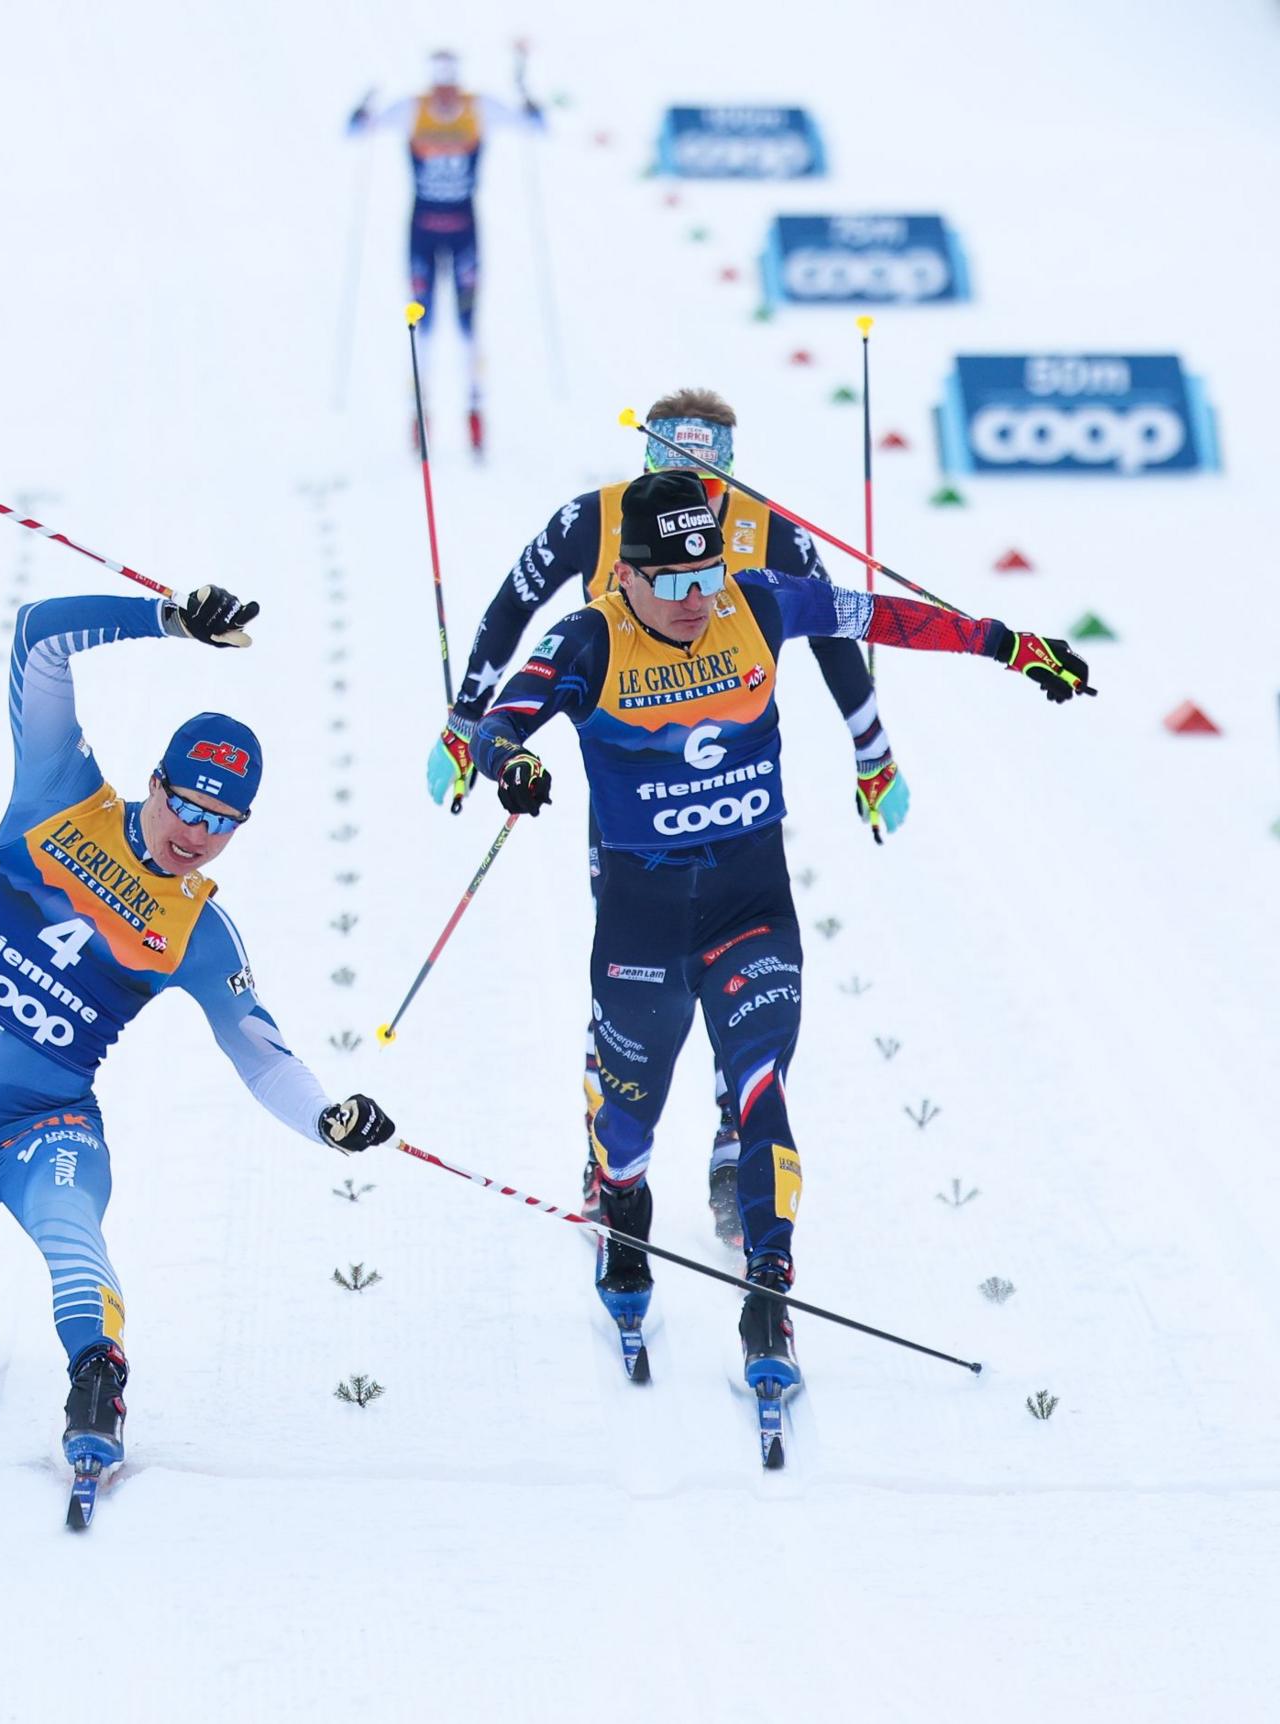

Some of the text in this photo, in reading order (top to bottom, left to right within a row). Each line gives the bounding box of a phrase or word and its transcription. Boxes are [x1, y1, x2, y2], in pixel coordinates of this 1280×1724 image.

[676, 432, 710, 443] BIRKIE
[973, 404, 1186, 471] coop
[661, 517, 676, 533] la
[524, 545, 546, 589] OYOTA
[536, 531, 556, 566] SA
[618, 668, 642, 695] LE
[624, 679, 736, 708] SWITZERLAND
[684, 725, 728, 770] 6
[636, 760, 774, 800] fiemme
[653, 788, 770, 836] coop
[51, 820, 84, 849] LE
[45, 843, 141, 928] SWITZERLAND
[37, 917, 95, 971] 4
[620, 966, 644, 977] Jean
[644, 968, 664, 979] Lain
[740, 956, 781, 975] CAISSE
[728, 987, 790, 1028] CRAFT
[598, 1025, 649, 1064] Rhône-Alpes
[601, 1067, 648, 1101] mfy
